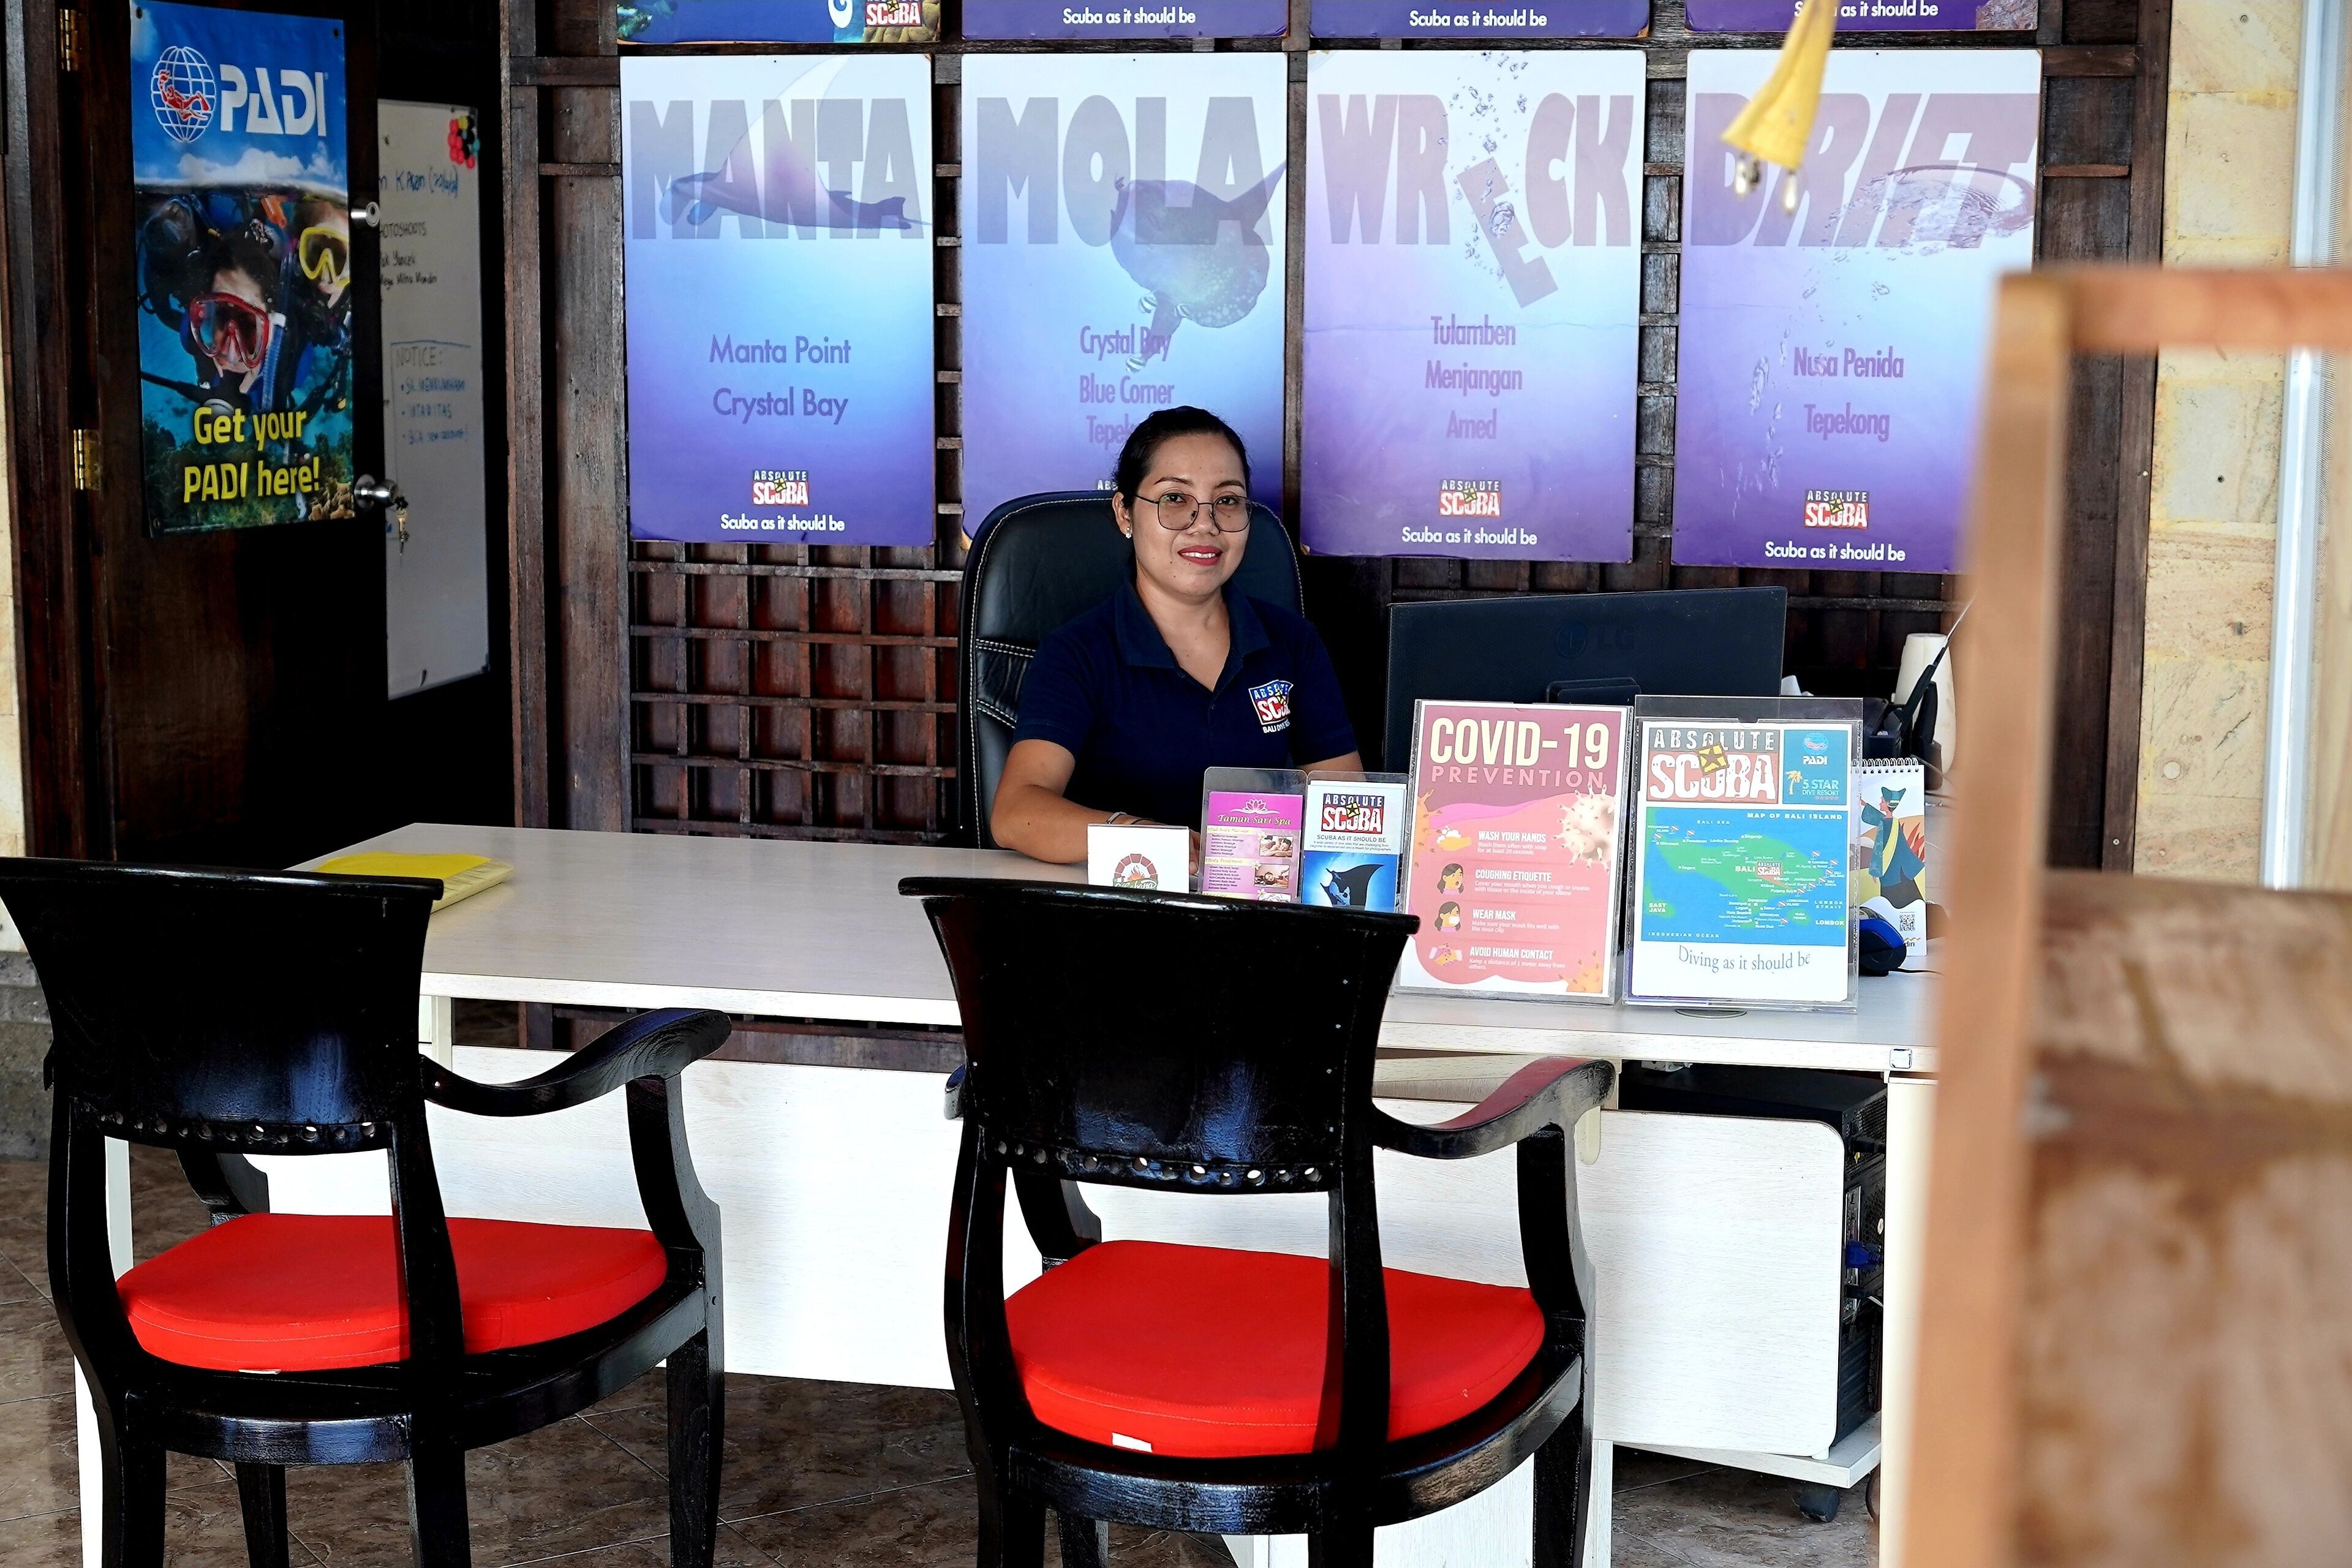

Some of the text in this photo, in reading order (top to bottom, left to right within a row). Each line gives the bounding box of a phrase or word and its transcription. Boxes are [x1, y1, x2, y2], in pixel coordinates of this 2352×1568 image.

[1063, 7, 1196, 24] Scuba as it should be
[1409, 9, 1547, 27] Scuba as it should be
[1841, 5, 1857, 17] as
[1860, 1, 1869, 17] it
[1871, 0, 1916, 17] should
[1920, 0, 1939, 16] be
[220, 64, 326, 137] PADI
[629, 98, 924, 239] MANTA
[977, 94, 1273, 247] MOLA
[1691, 92, 2040, 248] DRIFT
[1317, 92, 1634, 308] WRECK
[1080, 323, 1172, 361] Crystal Bay
[1430, 314, 1517, 346] Tulamben
[709, 333, 851, 364] Manta Point
[1793, 345, 1904, 379] Nusa Penida
[1079, 373, 1175, 404] Blue Corner
[1425, 359, 1523, 398] Menjangan
[713, 386, 848, 424] Crystal Bay
[194, 406, 307, 451] Get your
[1085, 413, 1136, 451] Tepek
[1446, 409, 1498, 440] Amed
[1804, 402, 1890, 442] Tepekong
[183, 456, 320, 503] PADI here!
[753, 470, 807, 481] ABSOLUTE
[1441, 480, 1500, 491] ABSOLUTE
[753, 481, 809, 505] SCUBA
[1440, 492, 1500, 516] SCUBA
[1807, 491, 1868, 502] ABSOLUTE
[720, 514, 845, 531] Scuba as it should be
[1805, 503, 1868, 527] SCUBA
[1401, 527, 1537, 545] Scuba as it should be
[1765, 541, 1906, 562] Scuba as it should be
[1430, 717, 1610, 770] COVID-19
[1654, 729, 1775, 751] ABSOLUTE
[1803, 755, 1828, 765] PADI
[1431, 766, 1604, 789] PREVENTION
[1649, 753, 1777, 800] SCUBA
[1802, 778, 1839, 790] 5 STAR
[1325, 794, 1382, 807] ABSOLUTE
[1218, 813, 1291, 827] Taman Sari Spa
[1322, 807, 1382, 832] SCUBA
[1478, 831, 1547, 843] WASH YOUR HANDS
[1475, 869, 1551, 882] COUGHING ETIQUETTE
[1757, 867, 1781, 876] SCUBA
[1472, 909, 1516, 920] WEAR MASK
[1469, 946, 1554, 960] AVOID HUMAN CONTACT
[1678, 944, 1811, 973] Diving as it should be
